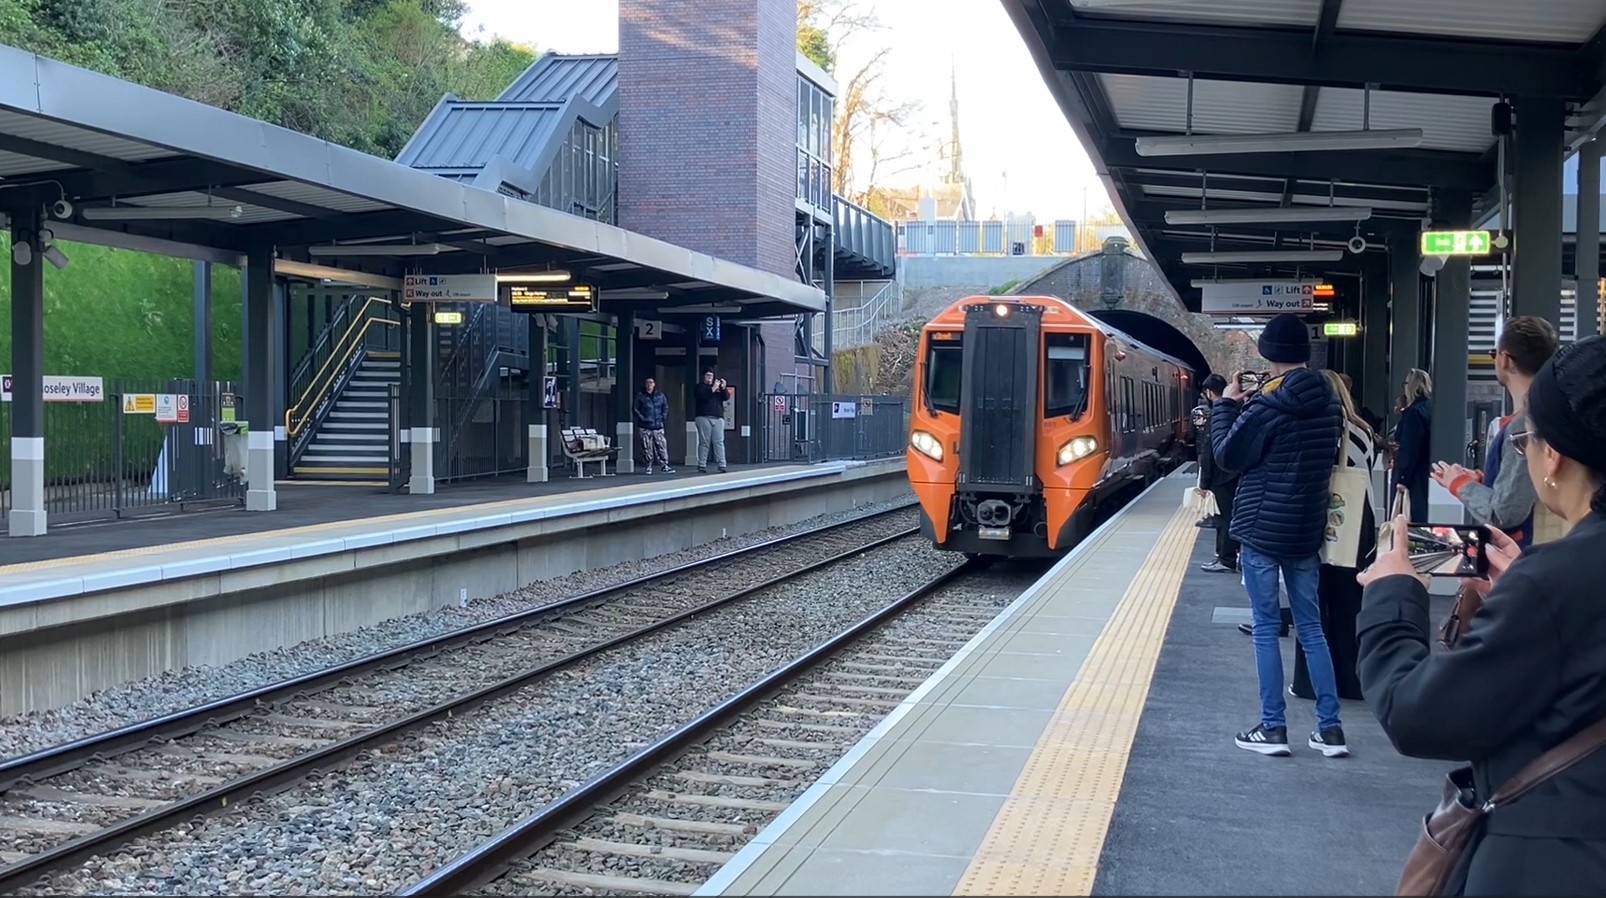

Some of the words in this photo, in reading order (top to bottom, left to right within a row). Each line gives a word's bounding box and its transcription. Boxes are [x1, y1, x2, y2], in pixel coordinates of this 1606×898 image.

[415, 278, 427, 286] Lift
[415, 290, 430, 298] Way
[1285, 286, 1300, 294] Lift
[1266, 300, 1283, 308] Way
[645, 323, 654, 336] 2
[1311, 327, 1320, 339] 1
[43, 382, 71, 396] oseley
[73, 382, 100, 396] Village
